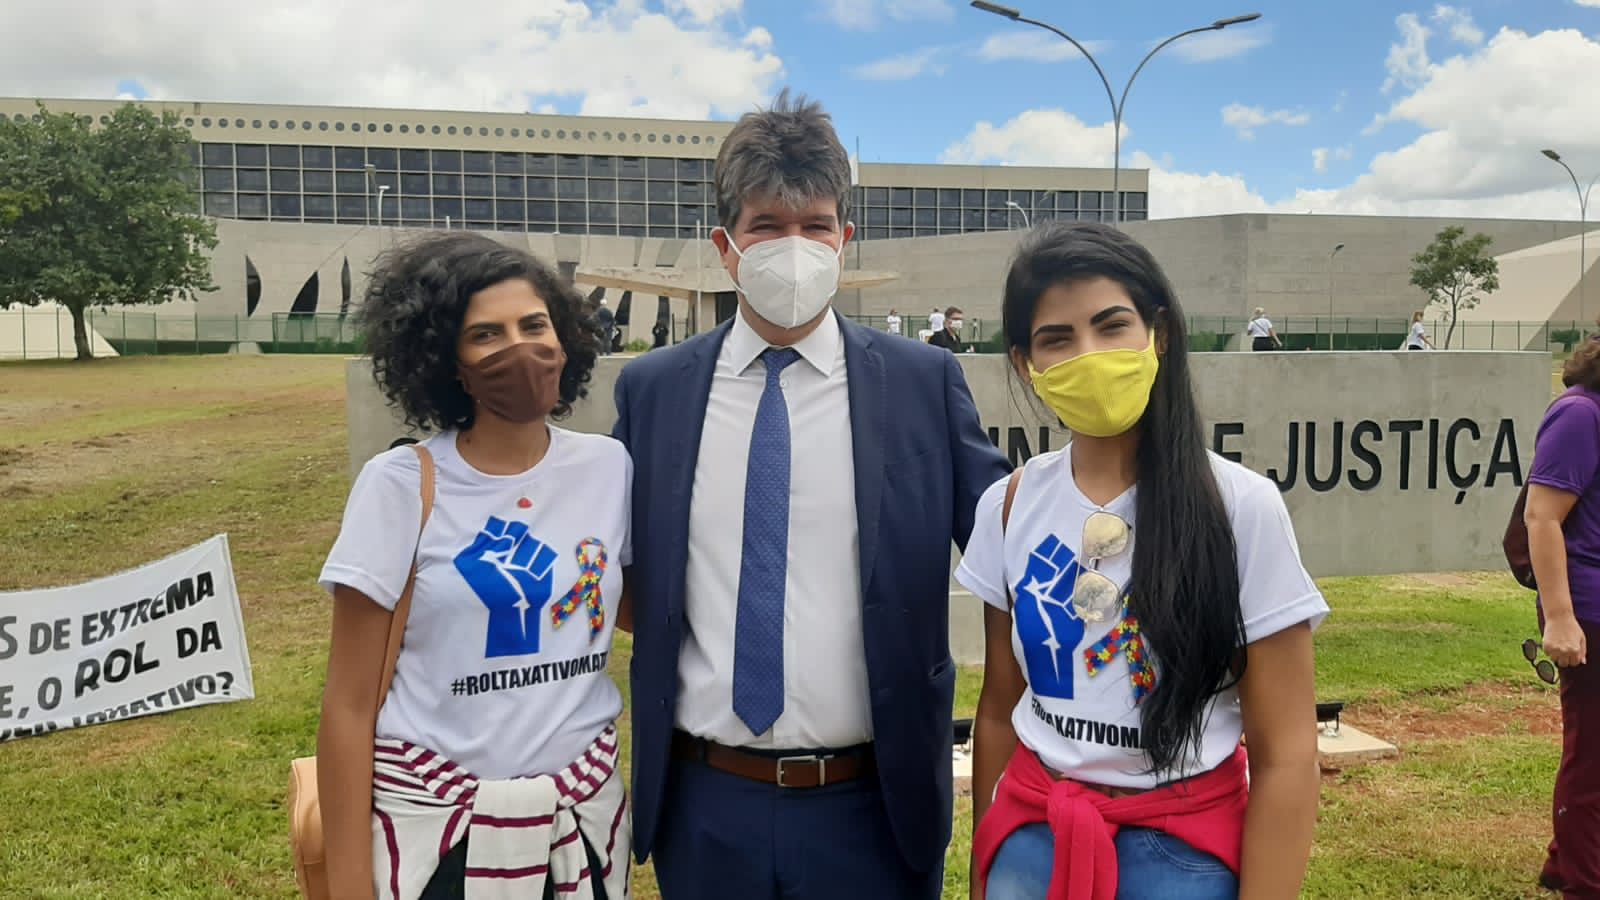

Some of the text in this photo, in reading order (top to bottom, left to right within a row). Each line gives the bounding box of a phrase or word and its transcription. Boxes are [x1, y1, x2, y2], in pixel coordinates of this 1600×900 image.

[1267, 418, 1523, 504] JUSTIÇA
[29, 618, 71, 655] DE
[81, 571, 215, 646] EXTREMA
[37, 677, 62, 711] O
[75, 641, 160, 698] ROL
[176, 621, 222, 659] DA
